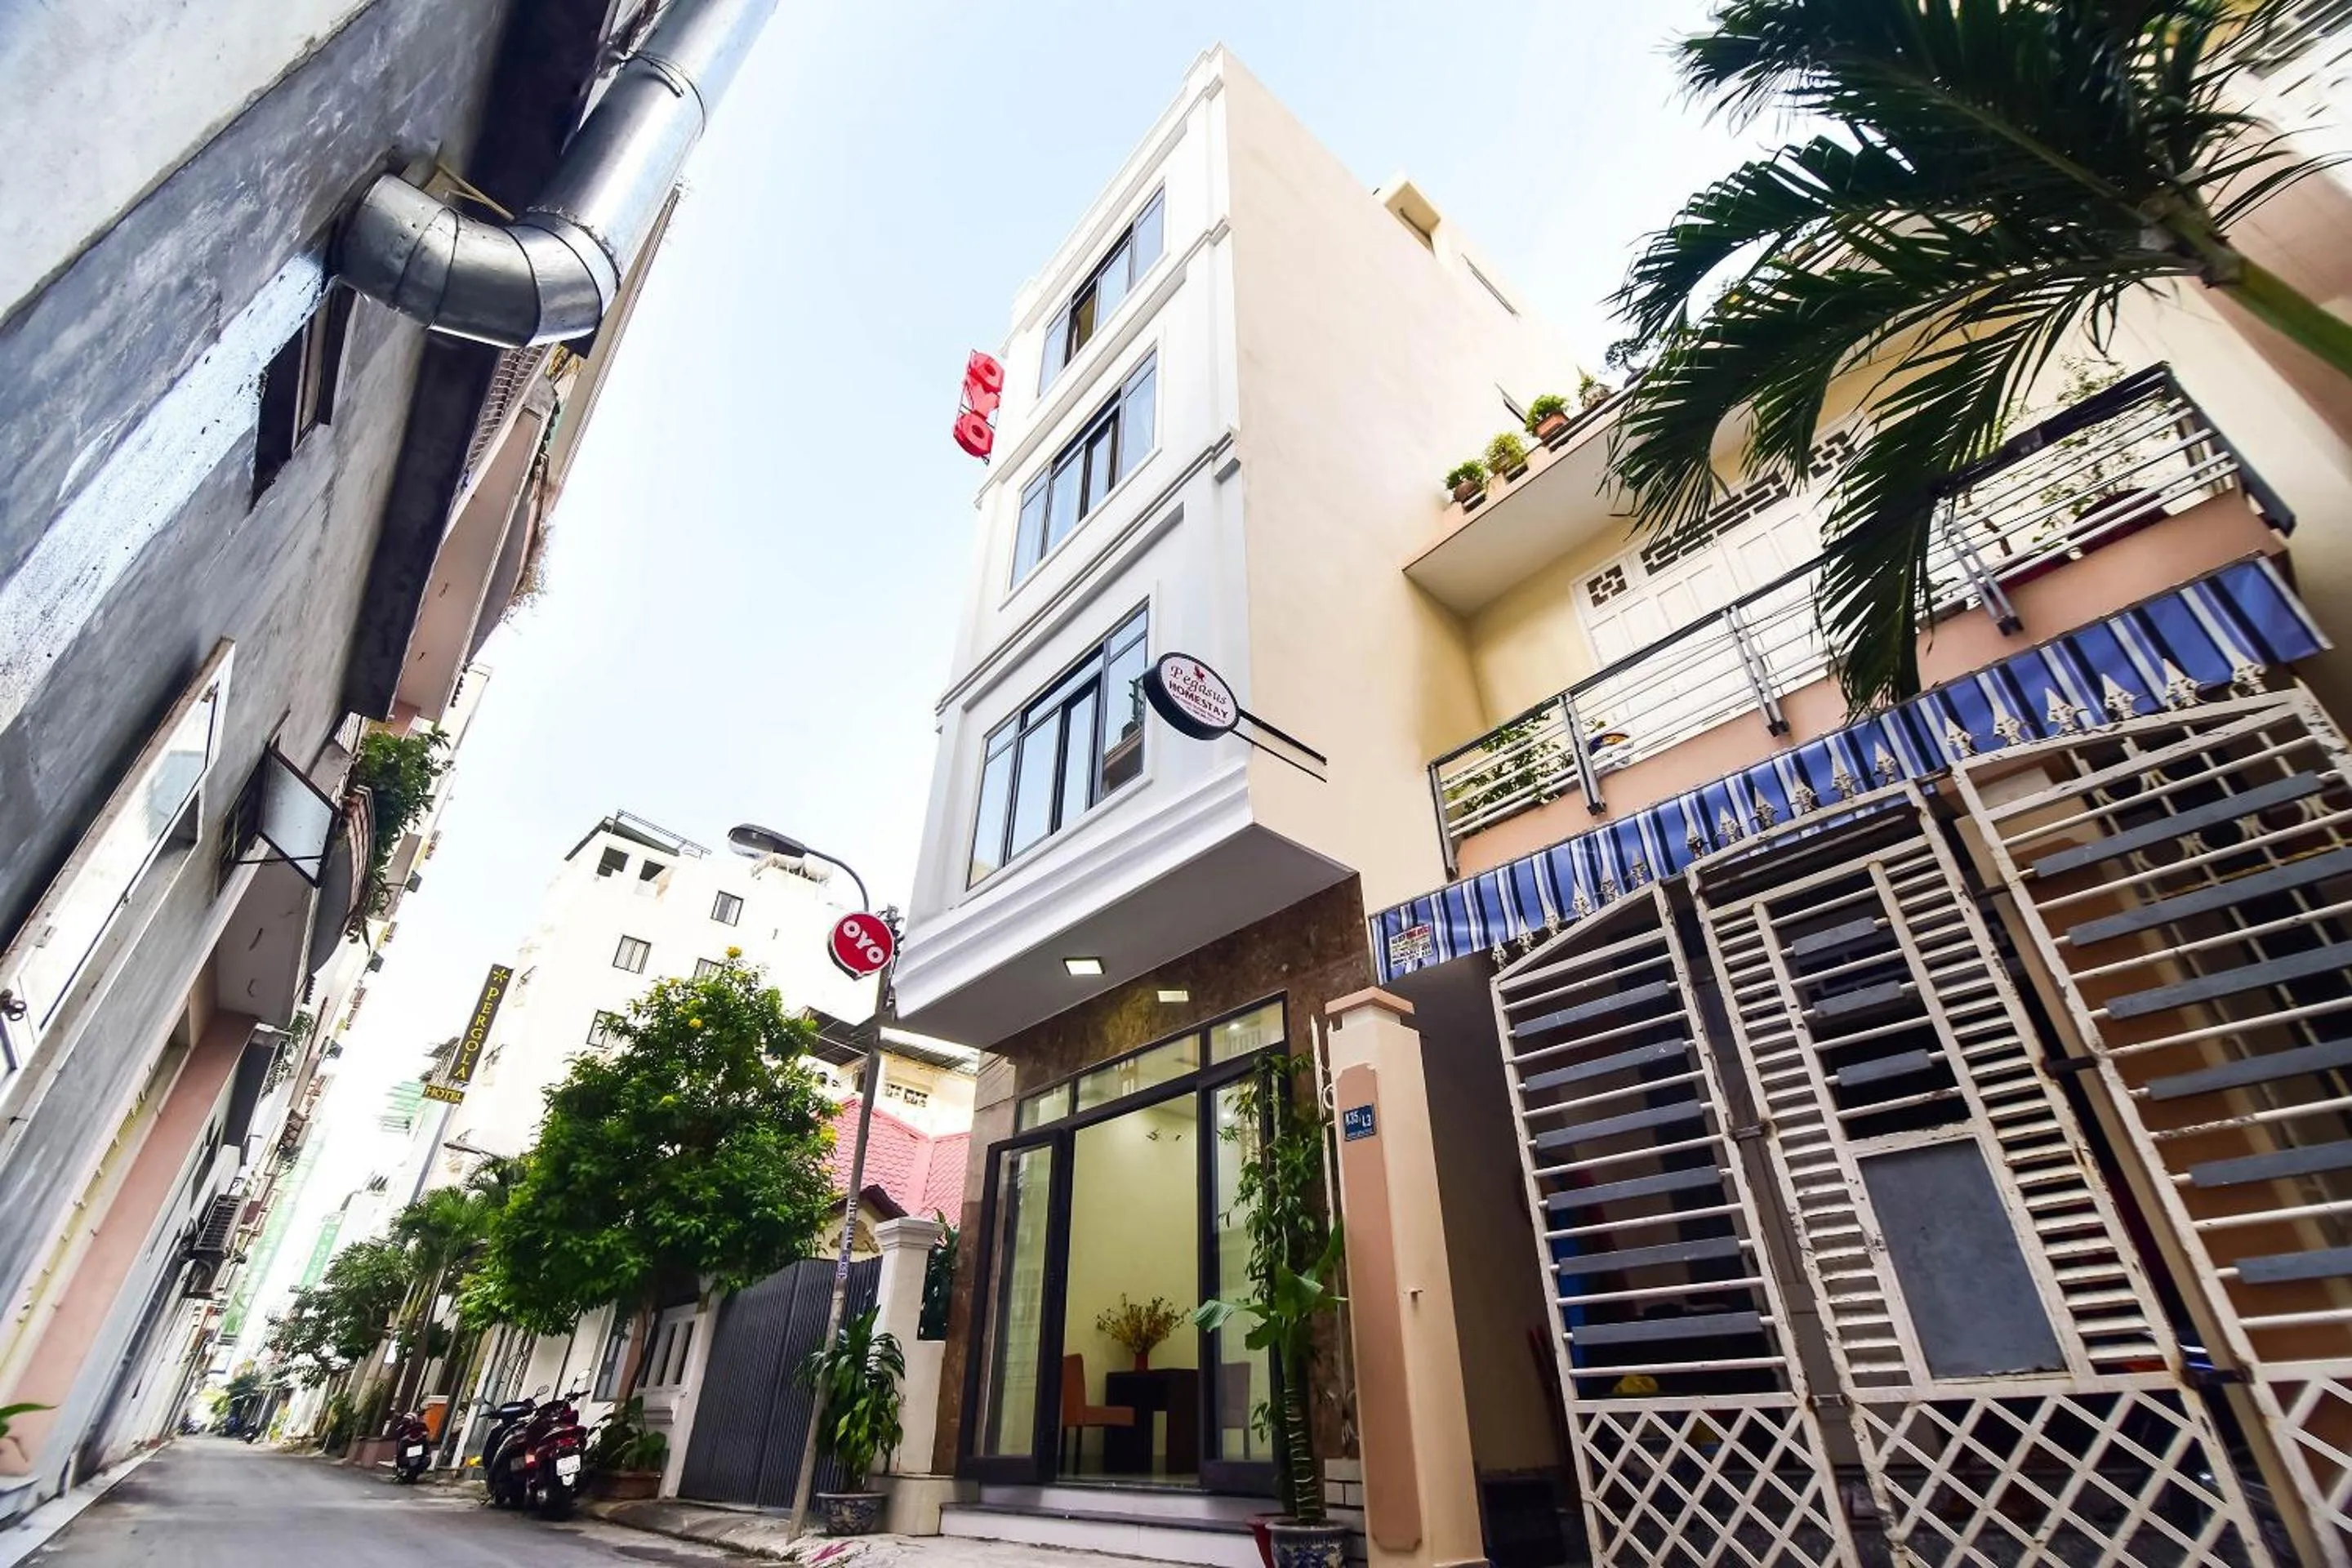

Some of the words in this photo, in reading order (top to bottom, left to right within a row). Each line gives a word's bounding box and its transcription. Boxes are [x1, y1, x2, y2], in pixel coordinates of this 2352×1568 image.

[954, 352, 1004, 457] OYO
[1169, 680, 1229, 718] HOMESTAY
[1170, 666, 1227, 705] Pegasus
[843, 920, 884, 964] OYO
[454, 987, 500, 1078] PERGOLA
